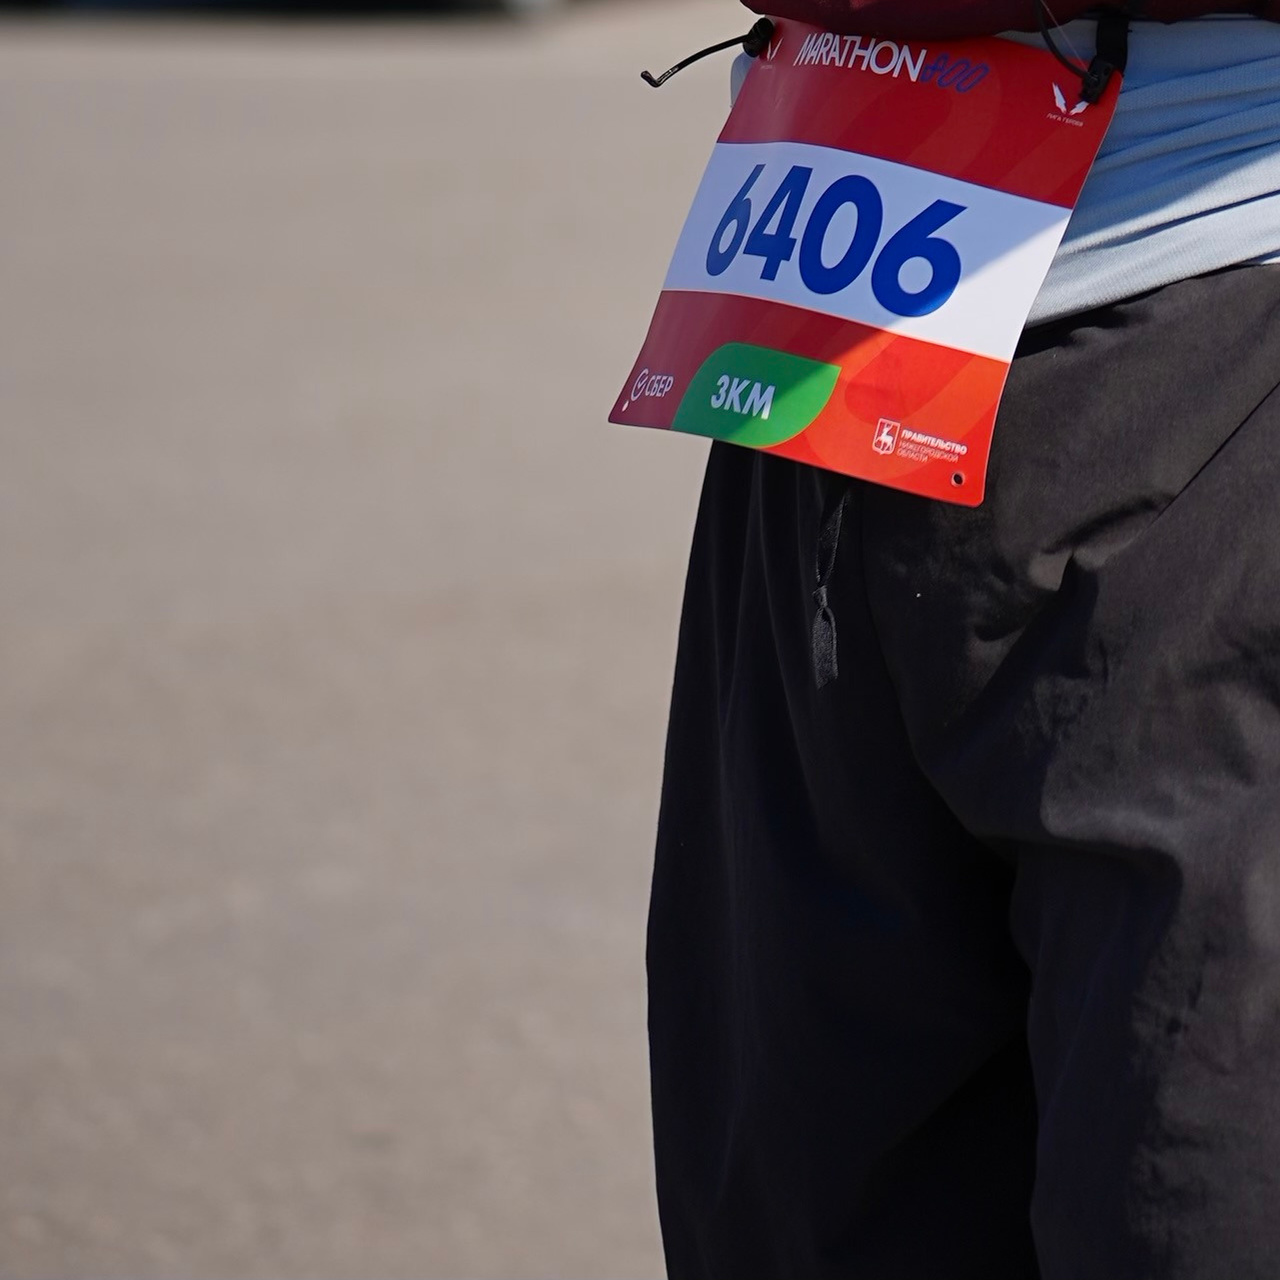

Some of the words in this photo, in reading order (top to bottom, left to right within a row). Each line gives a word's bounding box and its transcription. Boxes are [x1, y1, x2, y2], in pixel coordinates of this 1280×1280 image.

[793, 32, 927, 83] MARATHON
[706, 164, 968, 318] 6406
[644, 374, 674, 398] СБЕР
[900, 429, 968, 456] ПРАВИТЕЛЬСТВО
